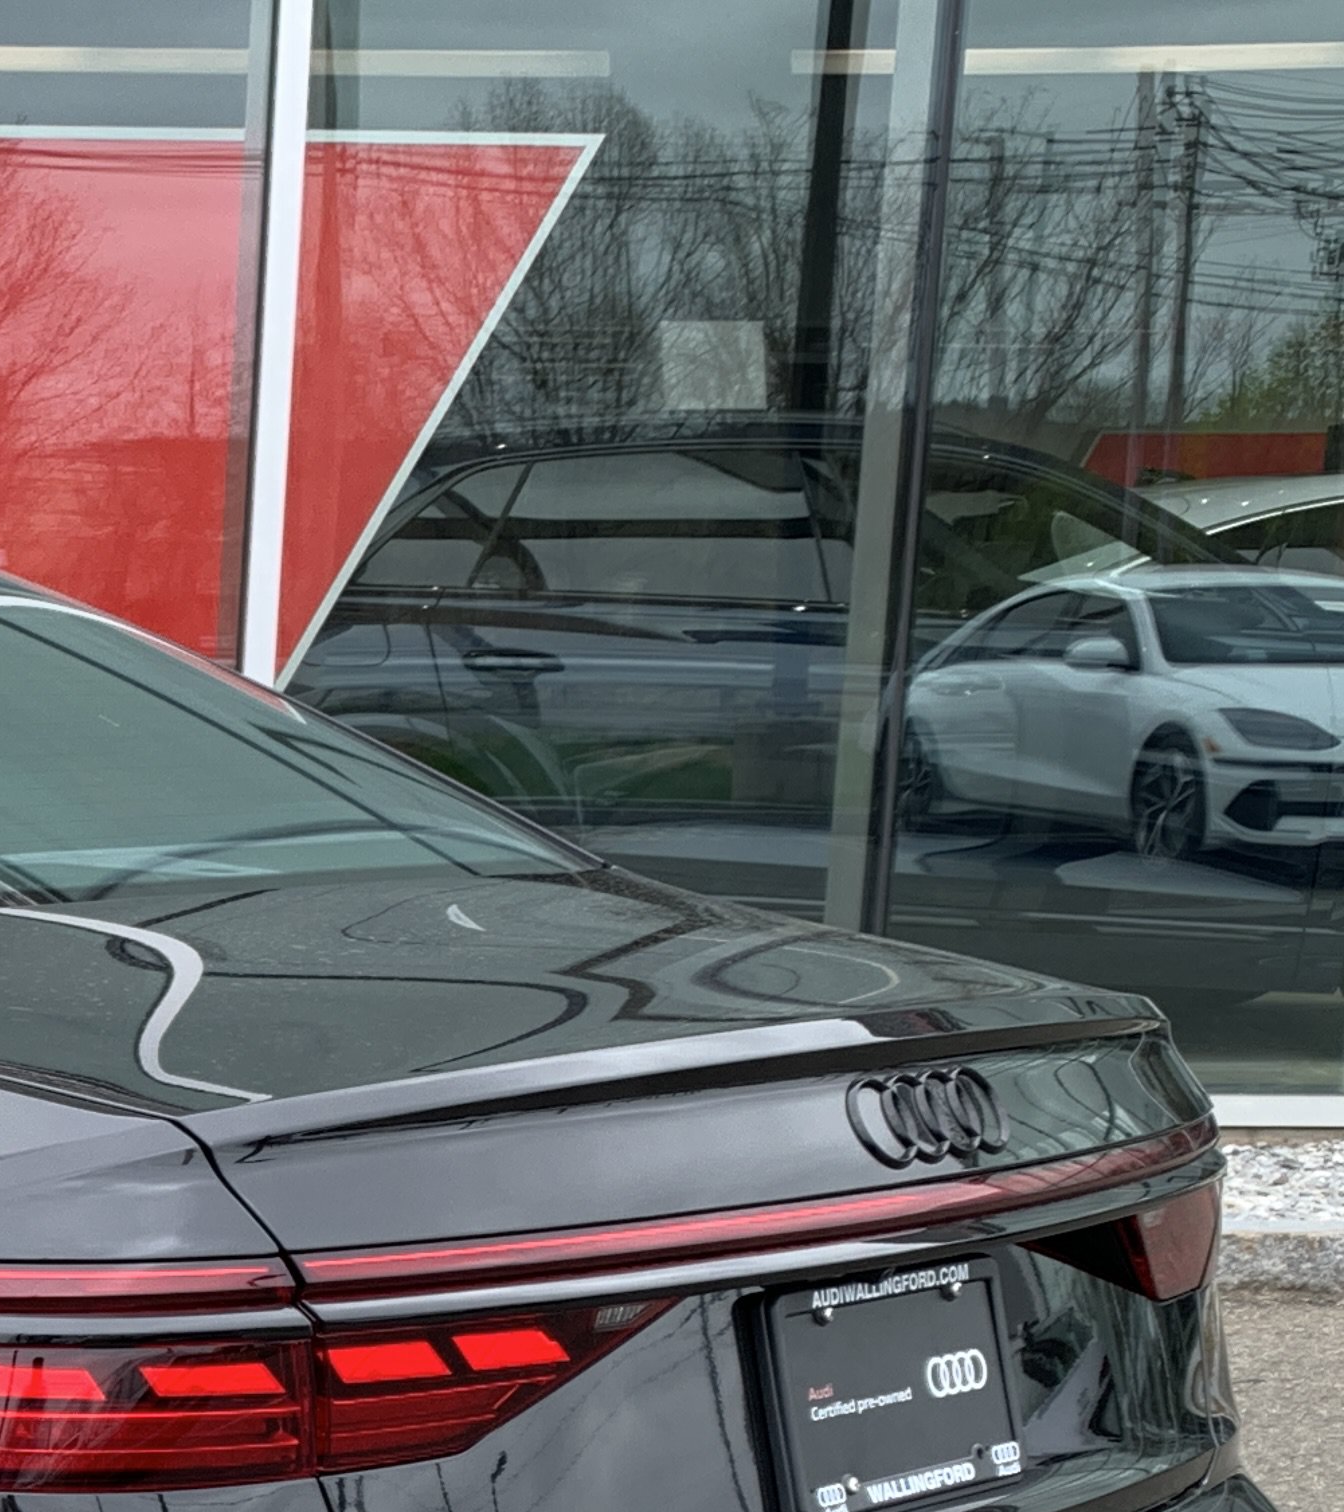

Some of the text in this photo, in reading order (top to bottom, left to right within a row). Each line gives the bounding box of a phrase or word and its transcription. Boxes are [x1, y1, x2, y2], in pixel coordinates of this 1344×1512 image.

[812, 1263, 969, 1309] AUDIWALLINGFORD.COM
[808, 1383, 833, 1401] Audi
[811, 1387, 912, 1421] Certified pre-owned
[867, 1463, 976, 1503] WALLINGFORD
[998, 1461, 1022, 1476] Audi
